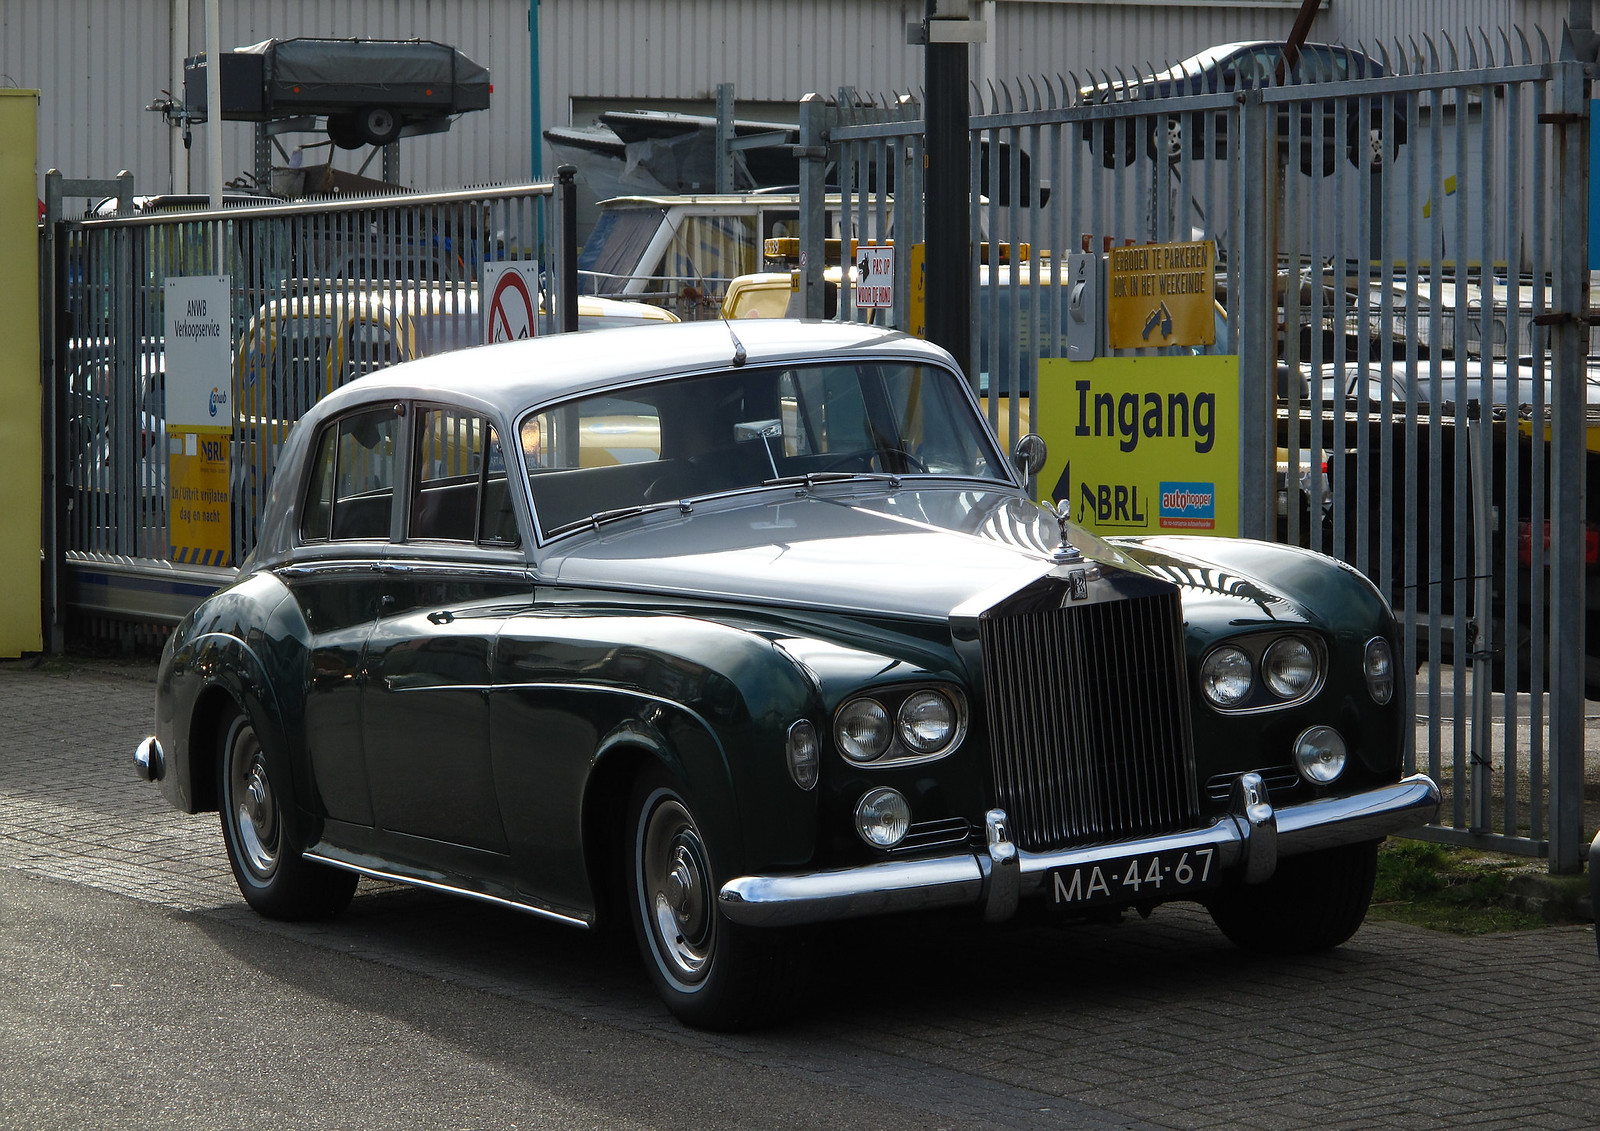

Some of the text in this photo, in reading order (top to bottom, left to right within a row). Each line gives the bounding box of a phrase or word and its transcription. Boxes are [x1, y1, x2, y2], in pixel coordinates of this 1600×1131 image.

[872, 258, 890, 275] PAS OP
[1152, 247, 1162, 270] TE
[1164, 244, 1208, 269] PARKEREN
[1114, 271, 1206, 297] OOK IN HET WEEKEINDE
[858, 286, 891, 303] VOOR DE HOND
[186, 299, 207, 317] ANWB
[174, 318, 220, 343] Verkoopservice
[1075, 380, 1216, 454] Ingang
[200, 488, 228, 505] vrijlaten
[1162, 489, 1212, 512] autohopper
[180, 507, 220, 525] dag en nacht
